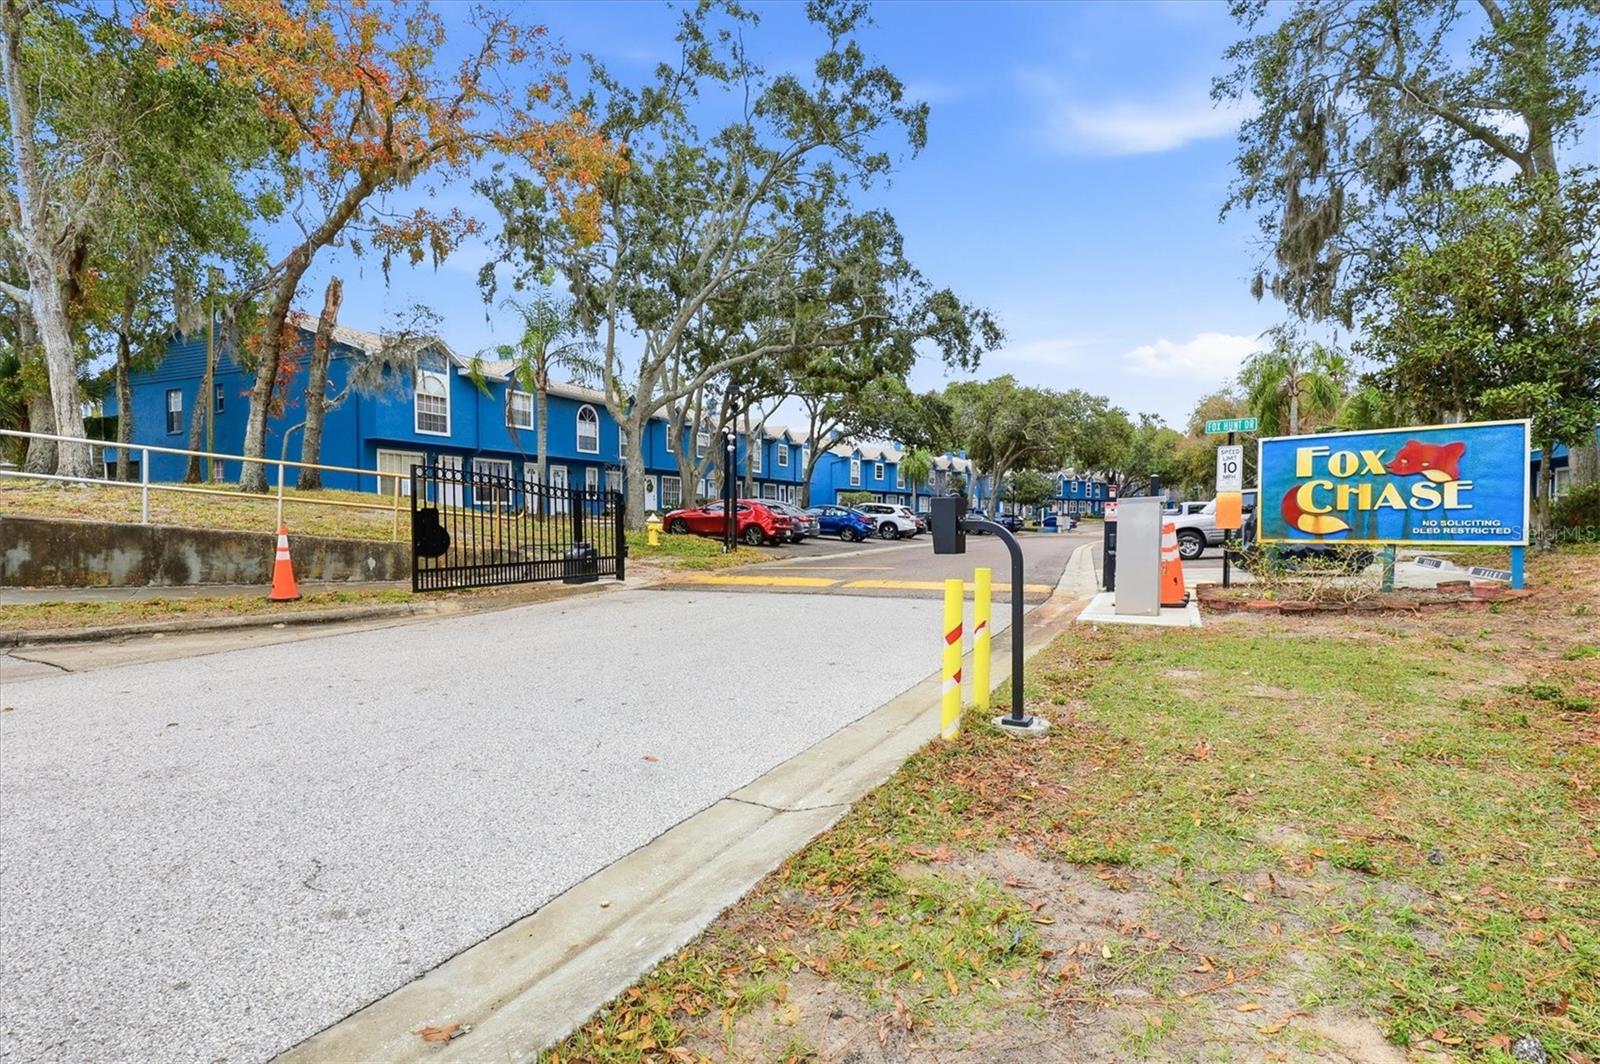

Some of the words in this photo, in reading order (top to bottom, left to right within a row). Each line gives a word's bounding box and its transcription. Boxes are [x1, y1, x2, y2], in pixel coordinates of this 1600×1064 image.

[1208, 421, 1221, 432] FOX
[1224, 420, 1242, 431] HUNT
[1244, 419, 1255, 430] DR
[1223, 461, 1237, 474] 10
[1296, 480, 1473, 514] CHASE
[1422, 519, 1437, 527] NO
[1440, 519, 1501, 527] SOLICITING
